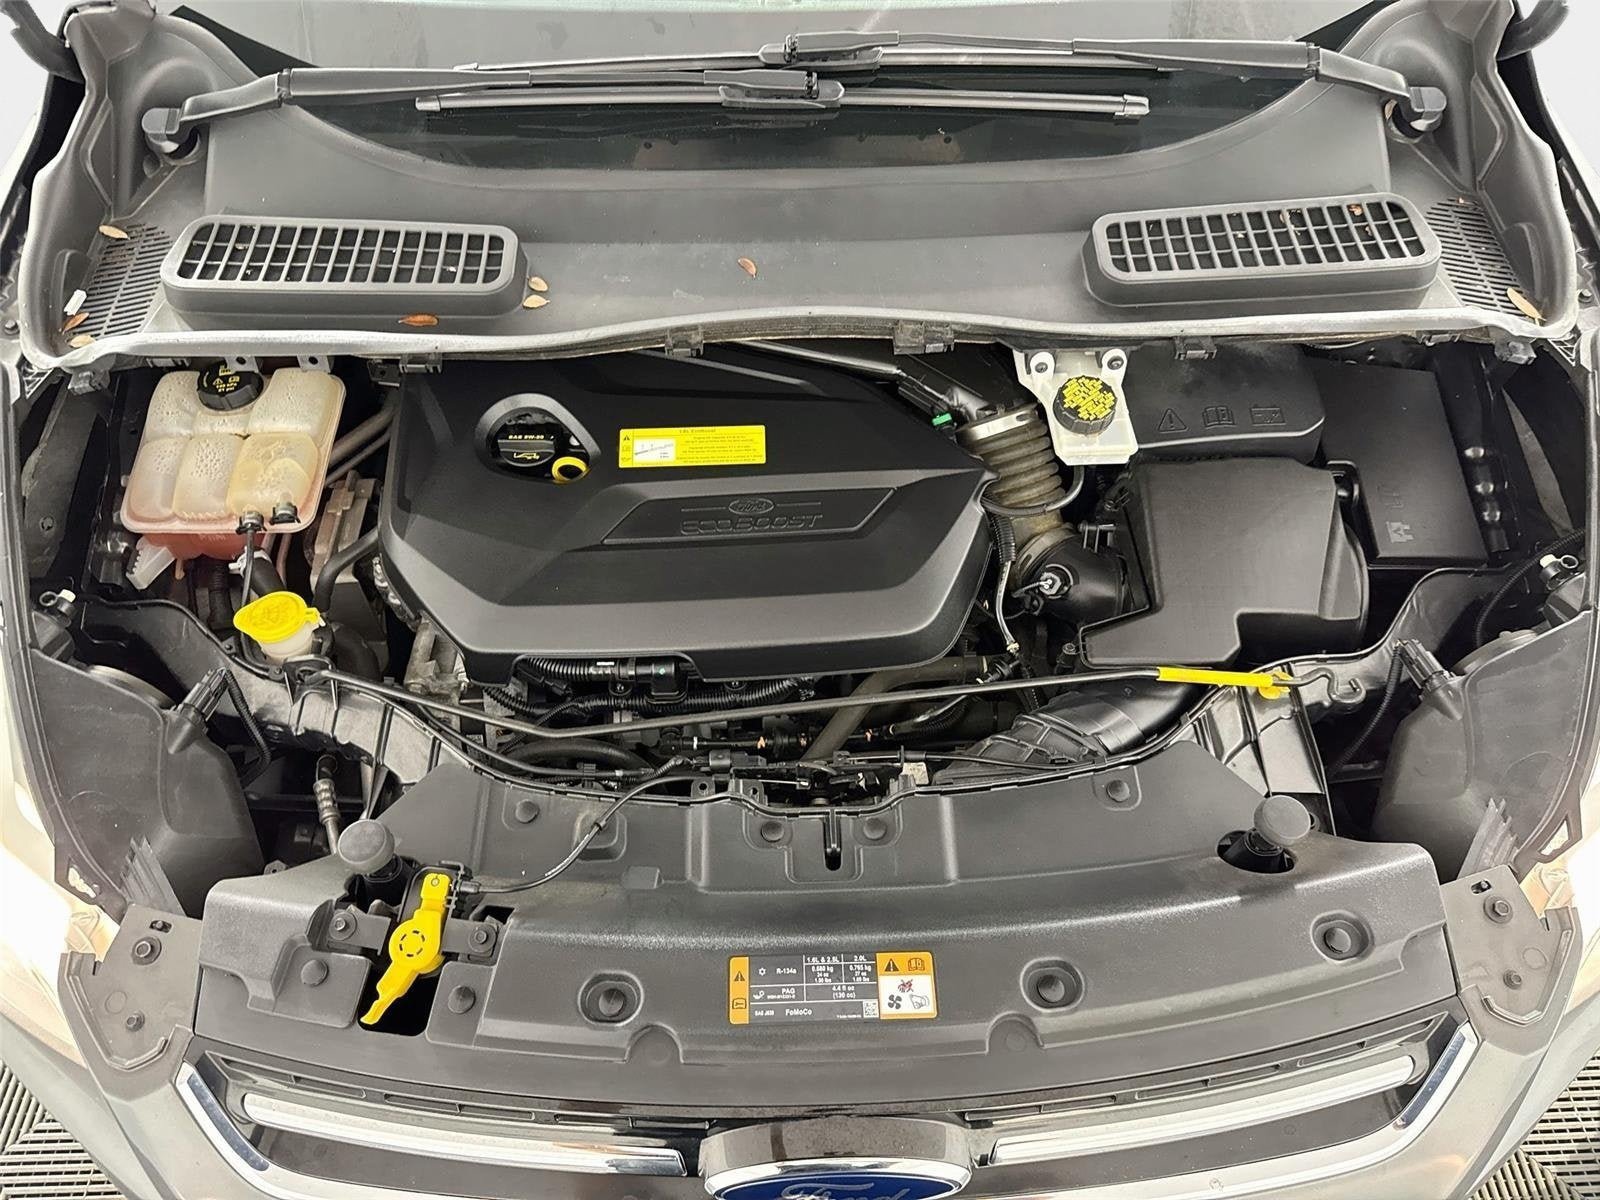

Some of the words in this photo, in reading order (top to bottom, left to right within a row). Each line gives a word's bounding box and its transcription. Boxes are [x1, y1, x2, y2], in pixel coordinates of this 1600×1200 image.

[853, 954, 867, 962] 2.0L
[776, 967, 797, 975] R-134a
[826, 965, 834, 973] kg
[864, 964, 872, 972] kg
[785, 1007, 813, 1016] FoMoCo
